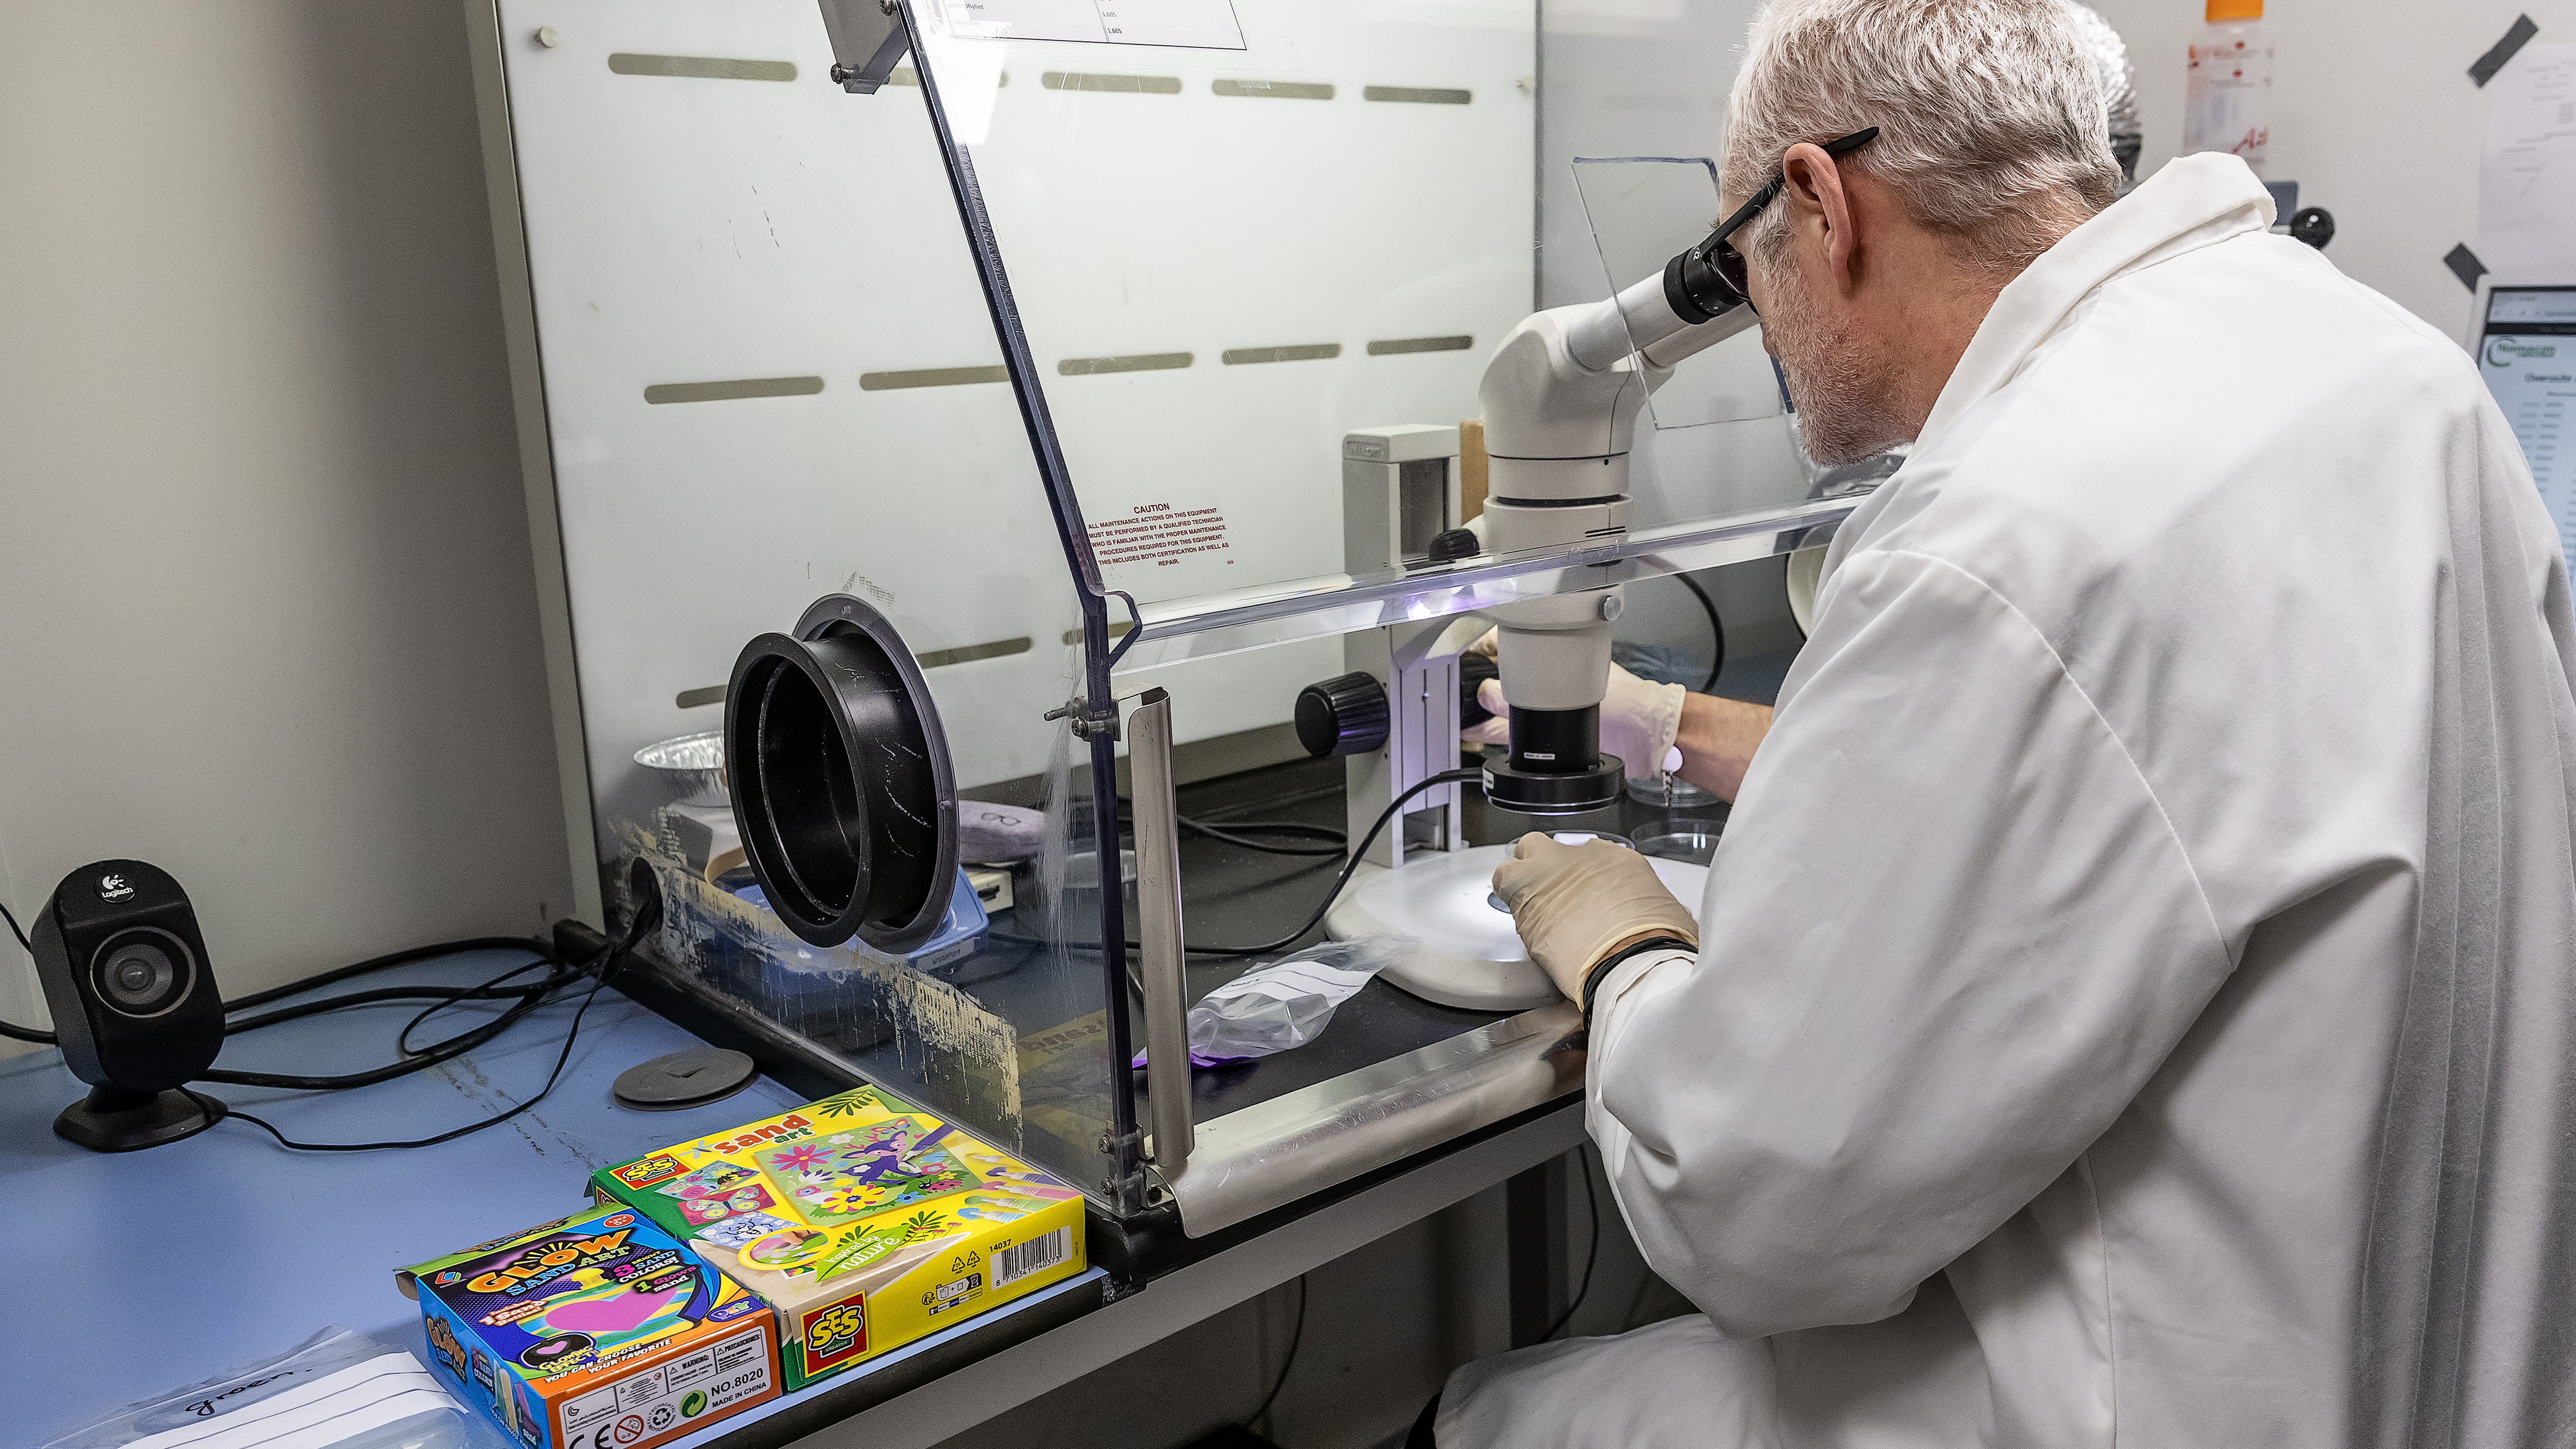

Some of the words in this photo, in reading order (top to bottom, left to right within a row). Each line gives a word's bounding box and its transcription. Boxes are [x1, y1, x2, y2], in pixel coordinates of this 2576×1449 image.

[1100, 518, 1140, 528] MAINTENANCE
[1141, 515, 1165, 523] ACTIONS
[1187, 508, 1217, 517] EQUIPMENT
[1134, 503, 1170, 514] CAUTION
[1113, 536, 1138, 545] FAMILIAR
[1166, 530, 1188, 538] PROPER
[1190, 525, 1226, 535] MAINTENANCE
[1115, 526, 1148, 535] PERFORMED
[1164, 520, 1192, 529] QUALIFIED
[1192, 516, 1223, 526] TECHNICIAN
[1099, 546, 1138, 556] PROCEDURES
[1139, 542, 1166, 551] REQUIRED
[1193, 534, 1224, 543] EQUIPMENT.
[1113, 555, 1140, 564] INCLUDES
[1158, 547, 1198, 557] CERTIFICATION
[101, 887, 133, 898] Logitech
[714, 1114, 811, 1154] sand
[774, 1128, 813, 1143] art
[624, 1158, 677, 1180] SES
[823, 1241, 865, 1263] Inspired
[862, 1235, 881, 1244] by
[839, 1237, 900, 1270] nature
[989, 1238, 1012, 1253] 14037
[466, 1229, 632, 1293] GLOW
[506, 1263, 576, 1296] SAND
[578, 1246, 631, 1267] ART
[614, 1264, 635, 1277] 3
[637, 1251, 676, 1270] SAND
[619, 1257, 680, 1283] COLORS!
[1006, 1267, 1031, 1282] 710341
[1035, 1256, 1060, 1270] 140373
[636, 1281, 652, 1293] 1
[497, 1301, 547, 1320] Sand
[811, 1307, 861, 1348] SES
[538, 1345, 593, 1371] GLOWING
[588, 1360, 619, 1374] YOUR
[621, 1338, 672, 1360] FAVORITE
[825, 1340, 848, 1352] CREATIVE
[544, 1371, 568, 1383] YOU
[571, 1361, 594, 1374] CAN
[598, 1343, 642, 1362] CHOOSE
[682, 1354, 709, 1370] WARNING:
[711, 1367, 764, 1397] NO.8020
[712, 1394, 733, 1408] MADE
[744, 1382, 767, 1395] CHINA
